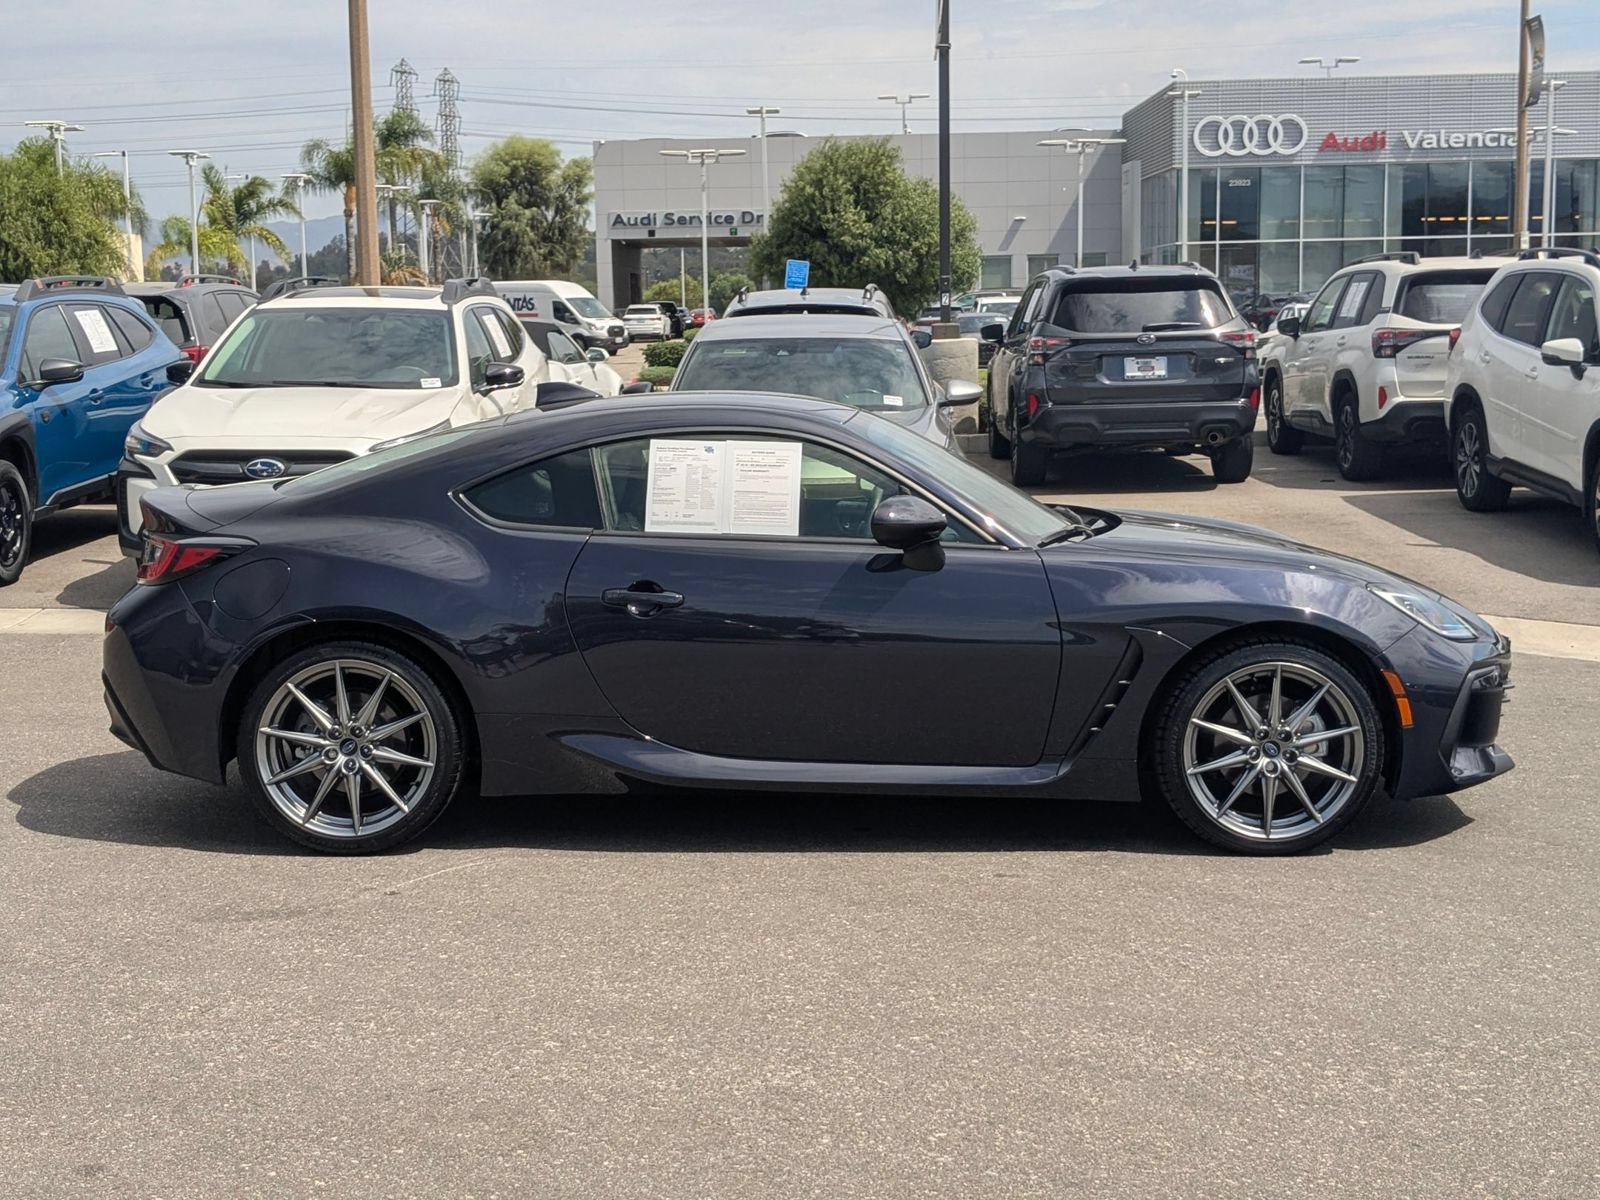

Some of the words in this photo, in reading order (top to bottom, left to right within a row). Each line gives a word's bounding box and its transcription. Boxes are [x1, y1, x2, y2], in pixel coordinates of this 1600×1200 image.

[1319, 130, 1387, 151] Audi
[612, 212, 657, 227] Audi
[663, 211, 735, 227] Service
